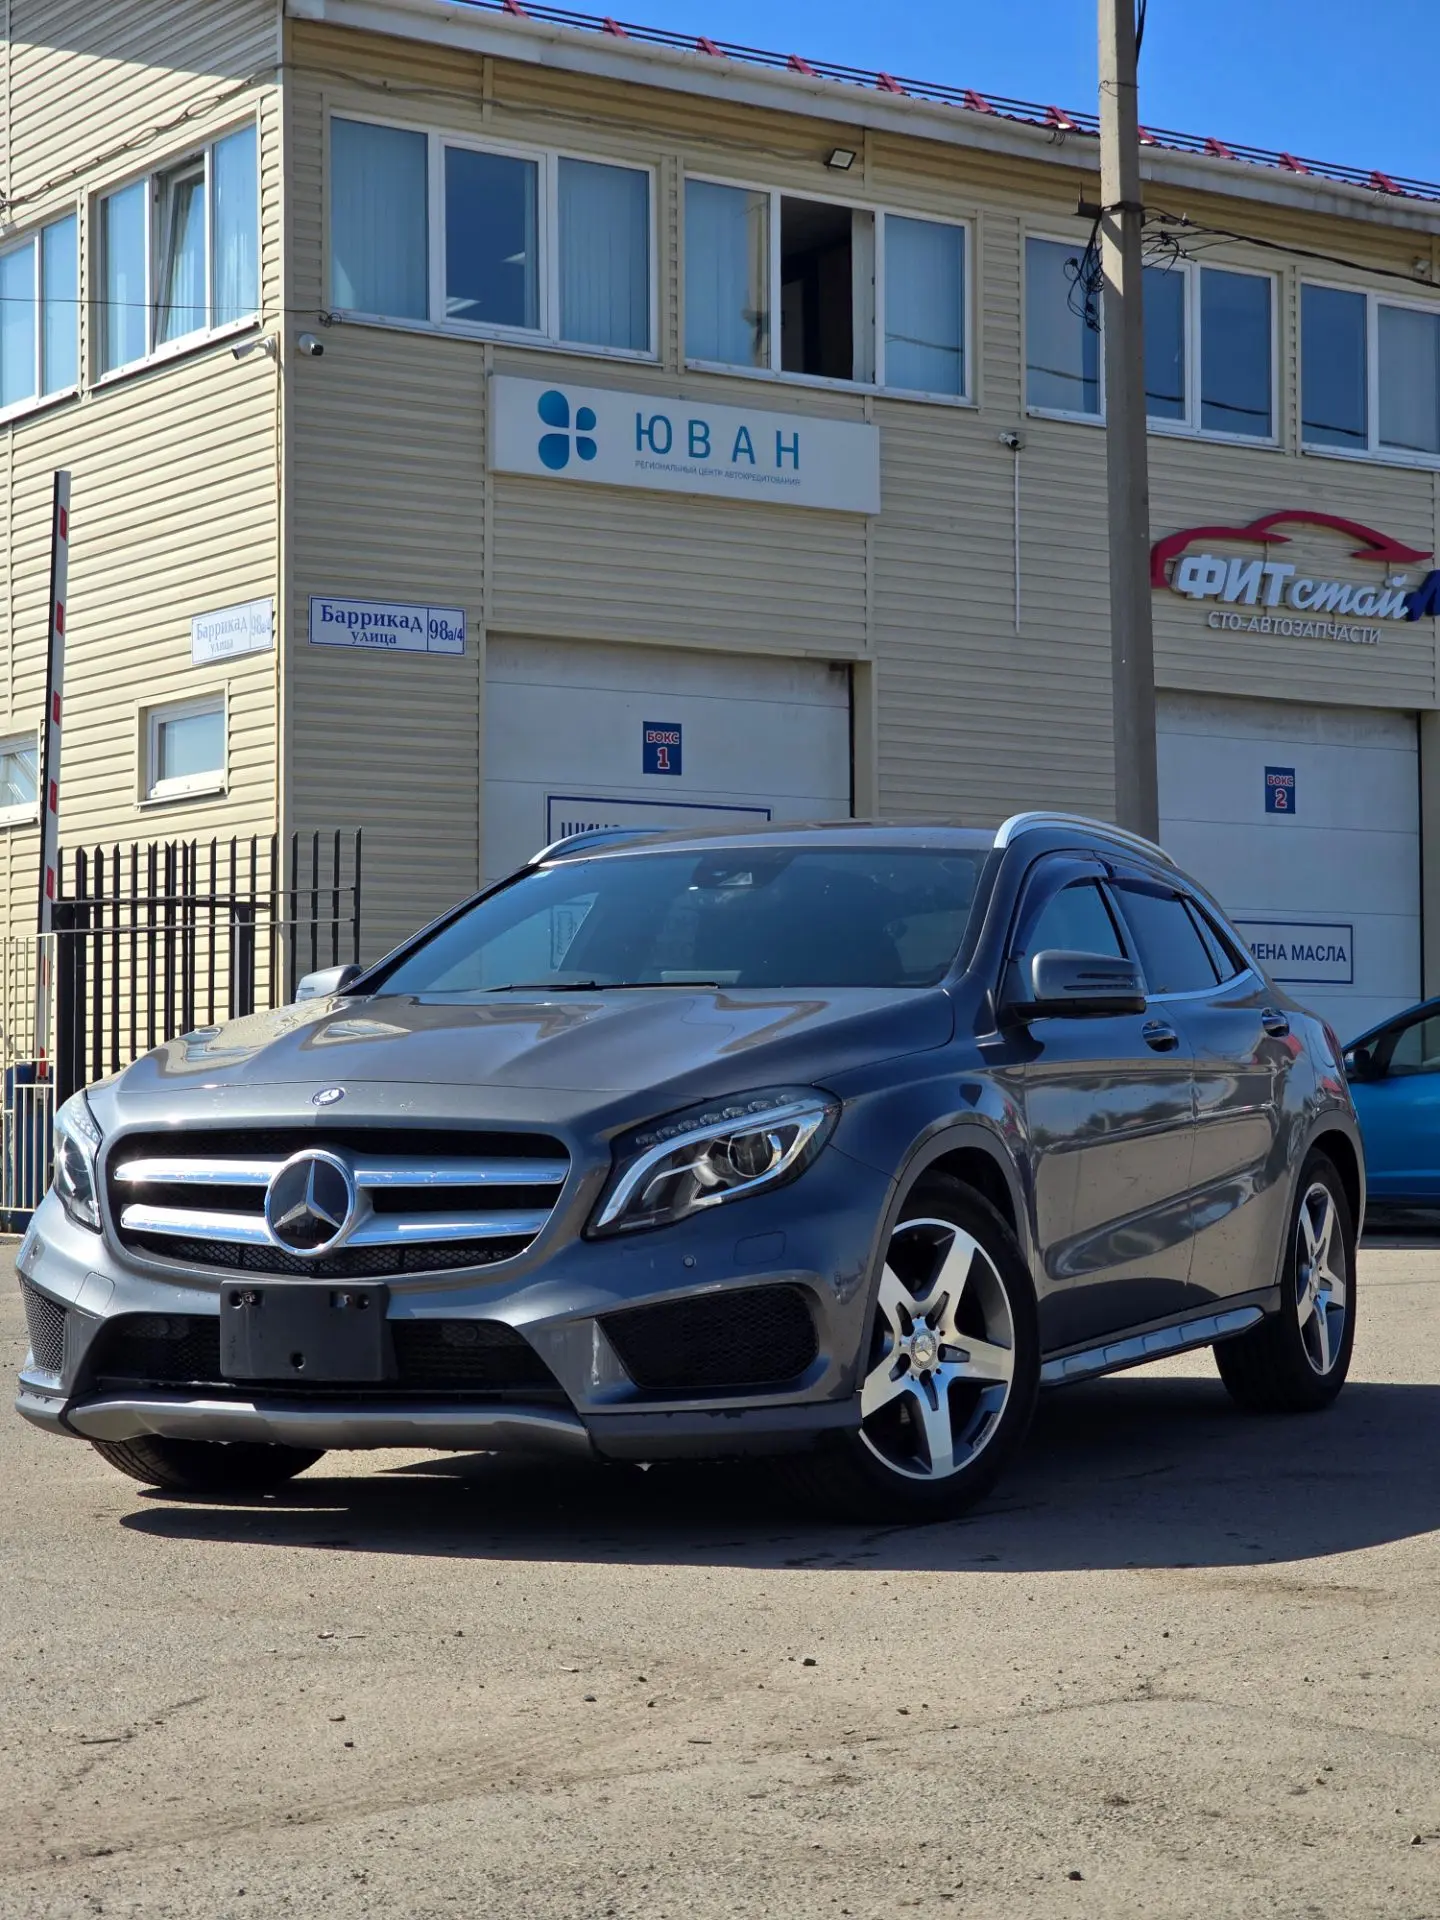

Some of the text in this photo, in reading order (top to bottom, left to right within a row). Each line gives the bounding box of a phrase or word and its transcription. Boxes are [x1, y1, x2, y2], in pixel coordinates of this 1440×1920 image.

[636, 411, 800, 470] ЮВАН
[634, 460, 801, 487] РЕГИОНАЛЬНЫЙ ЦЕНТР АВТОКРЕДИТОВАНИЯ
[196, 617, 248, 642] Баррикад
[321, 604, 464, 641] Баррикад 98а/4
[1208, 611, 1382, 644] СТО-АВТОЗАПЧАСТИ
[351, 631, 397, 645] улица
[646, 730, 680, 744] БОКС
[657, 747, 670, 769] 1
[1267, 775, 1294, 787] БОКС
[1275, 788, 1288, 809] 2
[1291, 945, 1347, 962] МАСЛА
